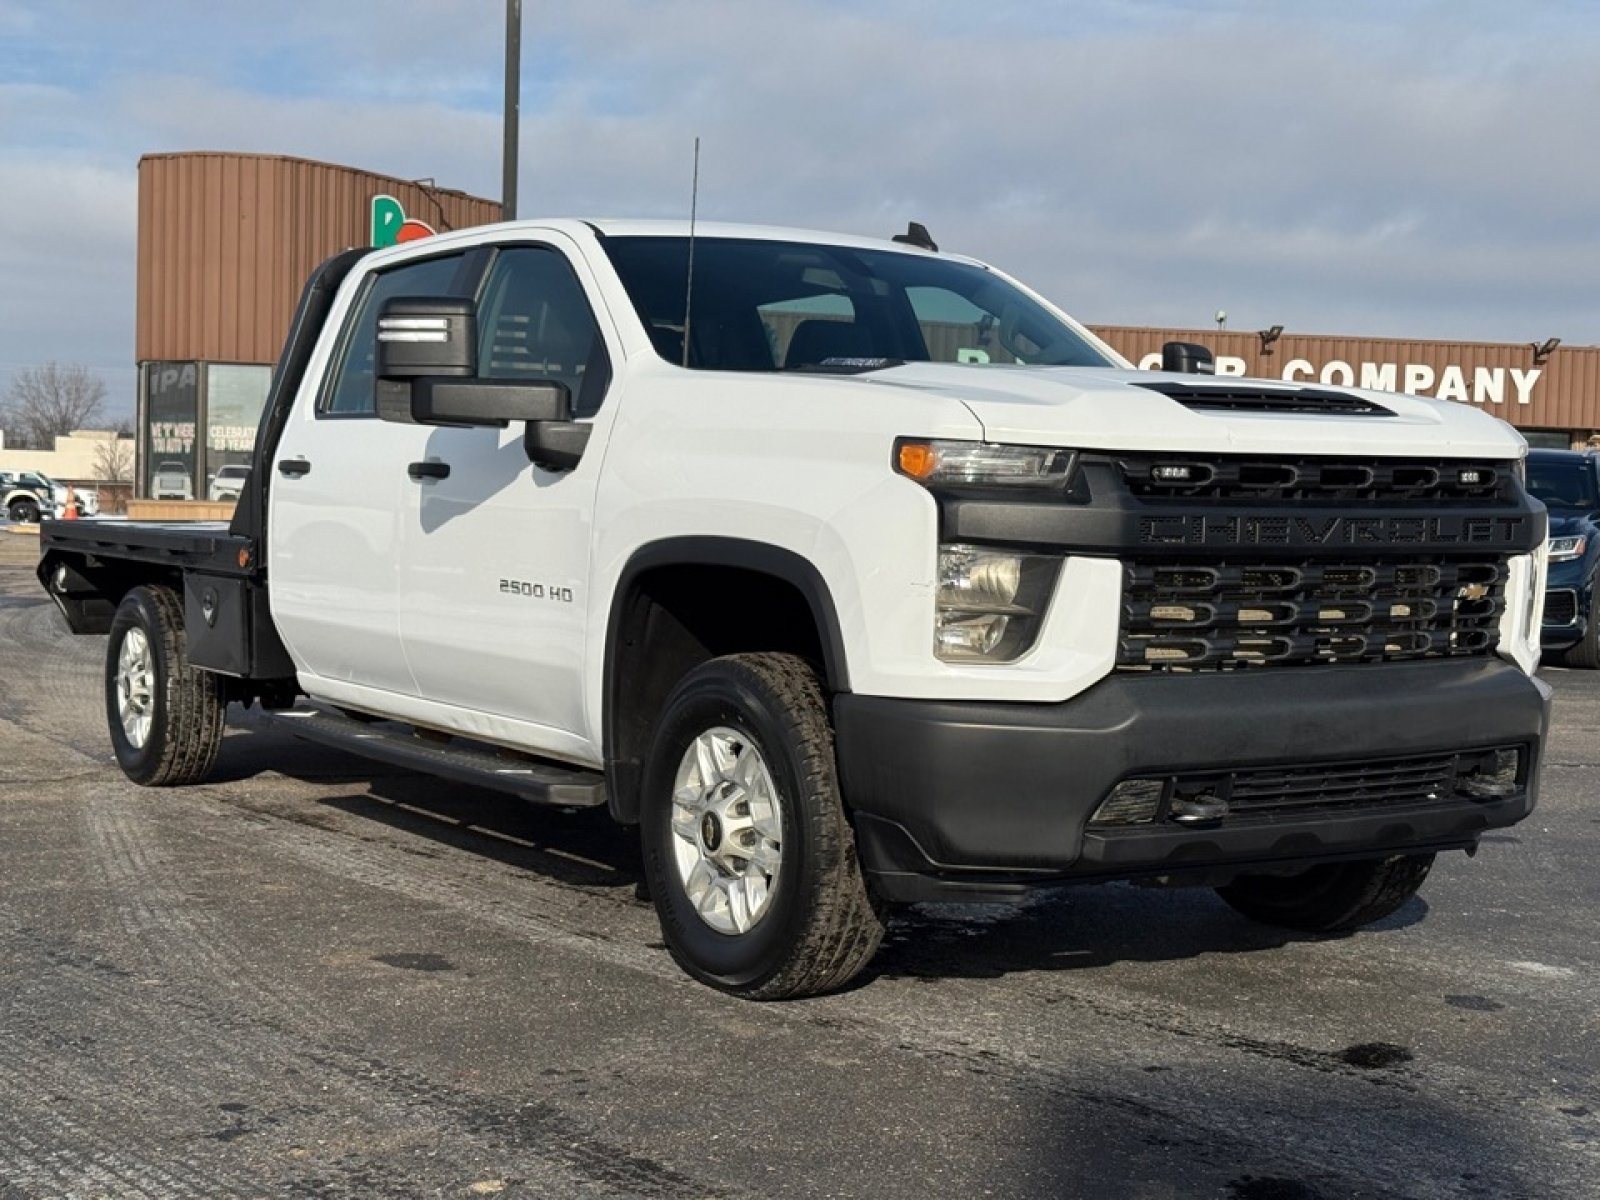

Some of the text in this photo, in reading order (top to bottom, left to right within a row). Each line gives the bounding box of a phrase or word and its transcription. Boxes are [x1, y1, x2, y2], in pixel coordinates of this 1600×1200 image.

[1282, 359, 1542, 404] COMPANY
[1139, 515, 1525, 544] CHEVROLET
[499, 579, 573, 602] 2500 HD
